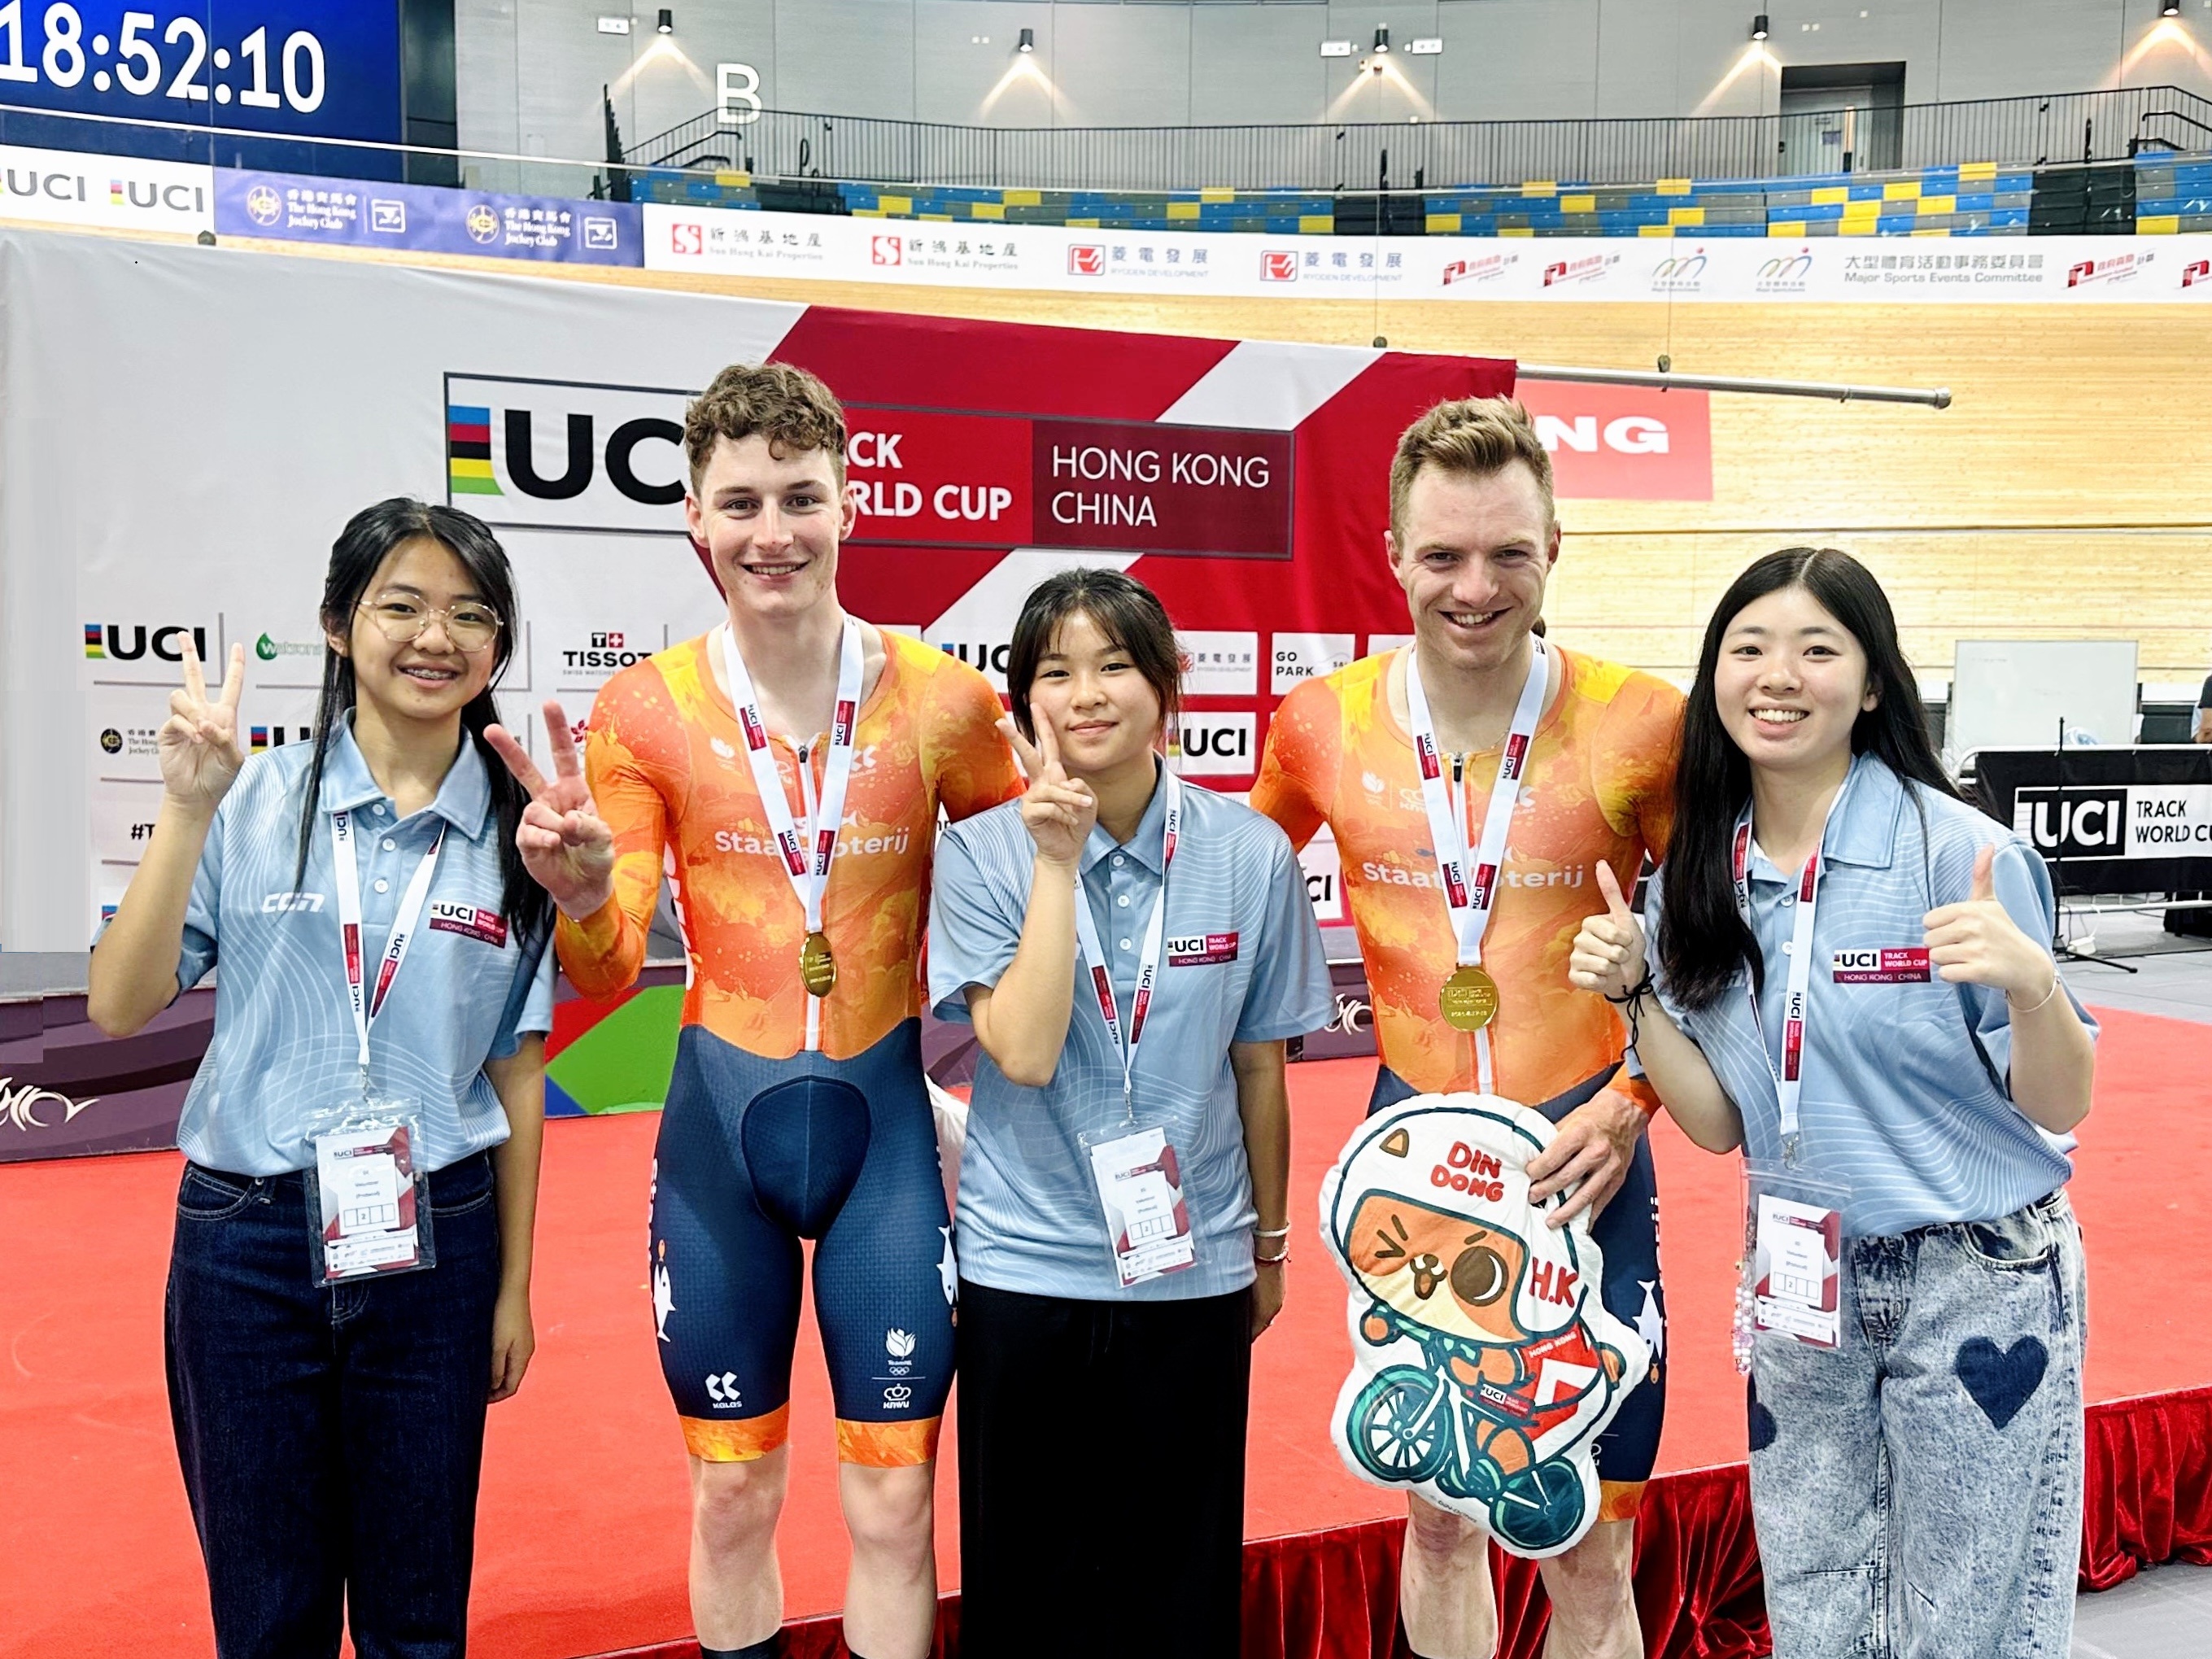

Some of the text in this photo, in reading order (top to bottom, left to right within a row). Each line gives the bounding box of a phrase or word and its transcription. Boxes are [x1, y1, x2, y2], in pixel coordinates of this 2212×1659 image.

[0, 0, 325, 113] 18:52:10
[714, 62, 761, 124] B
[7, 169, 85, 202] UCI
[126, 181, 204, 212] UCI
[1844, 273, 2043, 285] Major Sports Events Committee
[504, 409, 685, 505] UC
[1052, 445, 1270, 489] HONG KONG
[851, 480, 1012, 522] RLD CUP
[1052, 491, 1158, 527] CHINA
[959, 644, 1011, 674] UC
[1276, 652, 1298, 661] GO
[1276, 666, 1315, 676] PARK
[835, 725, 844, 741] UCI
[1183, 728, 1246, 757] UCI
[1504, 758, 1515, 775] UCI
[2136, 799, 2187, 818] TRACK
[338, 816, 347, 837] UCI
[2034, 800, 2120, 848] UCI
[788, 834, 797, 852] UCI
[2136, 825, 2190, 844] WORLD
[816, 854, 824, 872] UCI
[1451, 866, 1461, 883] UCI
[1305, 875, 1332, 902] CI
[1473, 888, 1482, 906] UCI
[440, 904, 473, 922] UCI
[389, 937, 404, 959] UCI
[1174, 939, 1204, 953] UCI
[1178, 956, 1198, 964] HONG
[1842, 953, 1877, 967] UCI
[1913, 958, 1928, 967] CUP
[1141, 969, 1152, 989] UCI
[1843, 972, 1922, 981] HONG KONG CHINA
[352, 985, 360, 1007] UCI
[1791, 998, 1801, 1019] UCI
[1446, 1141, 1503, 1179] DIN
[1430, 1164, 1505, 1202] DONG
[1529, 1256, 1578, 1308] H.K
[1554, 1330, 1577, 1347] KONG
[1486, 1387, 1504, 1402] UCI
